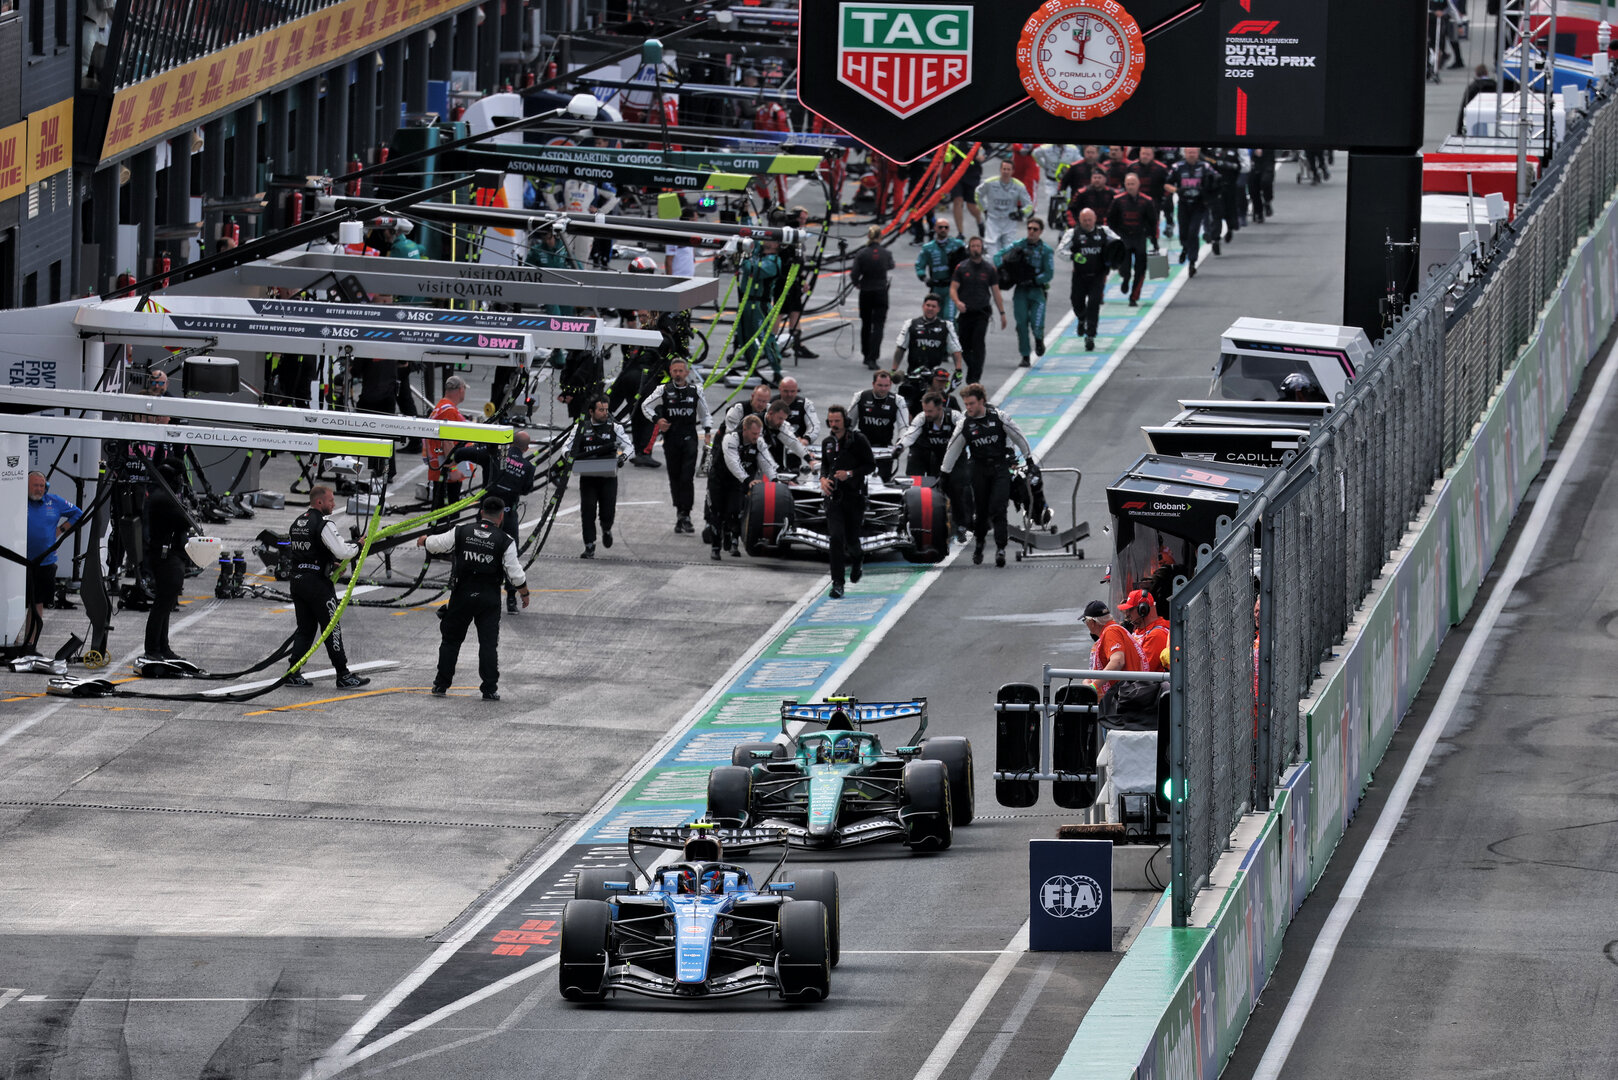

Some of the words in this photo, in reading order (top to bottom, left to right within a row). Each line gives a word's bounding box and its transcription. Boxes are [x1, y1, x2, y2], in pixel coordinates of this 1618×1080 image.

[851, 13, 961, 46] TAG
[1025, 18, 1037, 34] 50
[1127, 22, 1138, 35] 10
[1018, 48, 1027, 63] 45
[1225, 45, 1276, 55] DUTCH
[1135, 53, 1143, 64] 15
[1225, 56, 1278, 66] GRAND
[1280, 56, 1316, 67] PRIX
[1225, 69, 1254, 78] 2026
[846, 53, 963, 106] HEUER
[1022, 76, 1035, 91] 40
[1124, 80, 1137, 95] 20
[1042, 101, 1057, 113] 35
[1101, 102, 1116, 114] 25
[1072, 111, 1086, 119] 30
[541, 151, 573, 161] ASTON
[575, 153, 610, 162] MARTIN
[617, 153, 662, 164] aramco
[733, 157, 759, 168] arm
[508, 161, 537, 172] ASTON
[538, 164, 568, 174] MARTIN
[574, 166, 613, 179] aramco
[674, 175, 697, 186] arm
[460, 268, 543, 283] visitQATAR
[418, 281, 503, 297] visitQATAR
[275, 305, 314, 313] CASTORE
[407, 311, 434, 321] MSC
[196, 321, 237, 329] CASTORE
[562, 321, 590, 332] BWT
[332, 327, 359, 338] MSC
[489, 338, 518, 348] BWT
[667, 408, 688, 417] TWG
[322, 418, 377, 428] CADILLAC
[186, 432, 247, 442] CADILLAC
[1153, 502, 1186, 511] Globant
[463, 550, 485, 563] TWG
[649, 829, 770, 846] ATLASIAN
